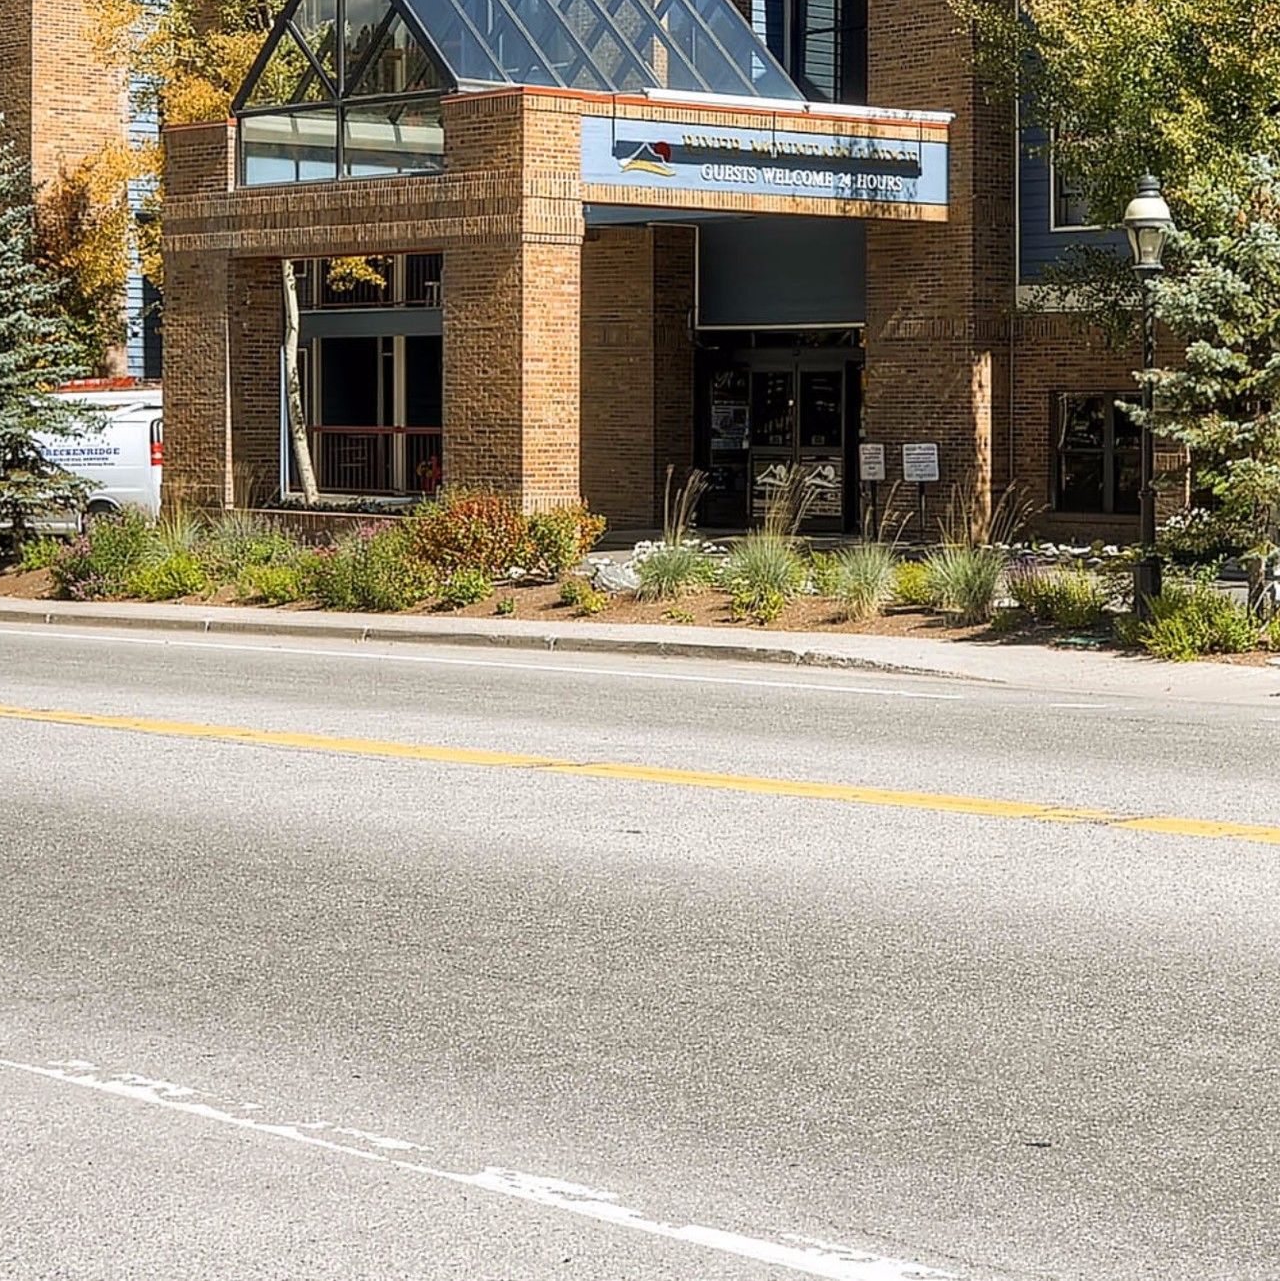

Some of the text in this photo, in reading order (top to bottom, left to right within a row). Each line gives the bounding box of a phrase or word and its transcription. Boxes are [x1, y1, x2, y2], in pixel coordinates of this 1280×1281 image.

[701, 163, 903, 192] GUESTS WELCOME 24 HOURS
